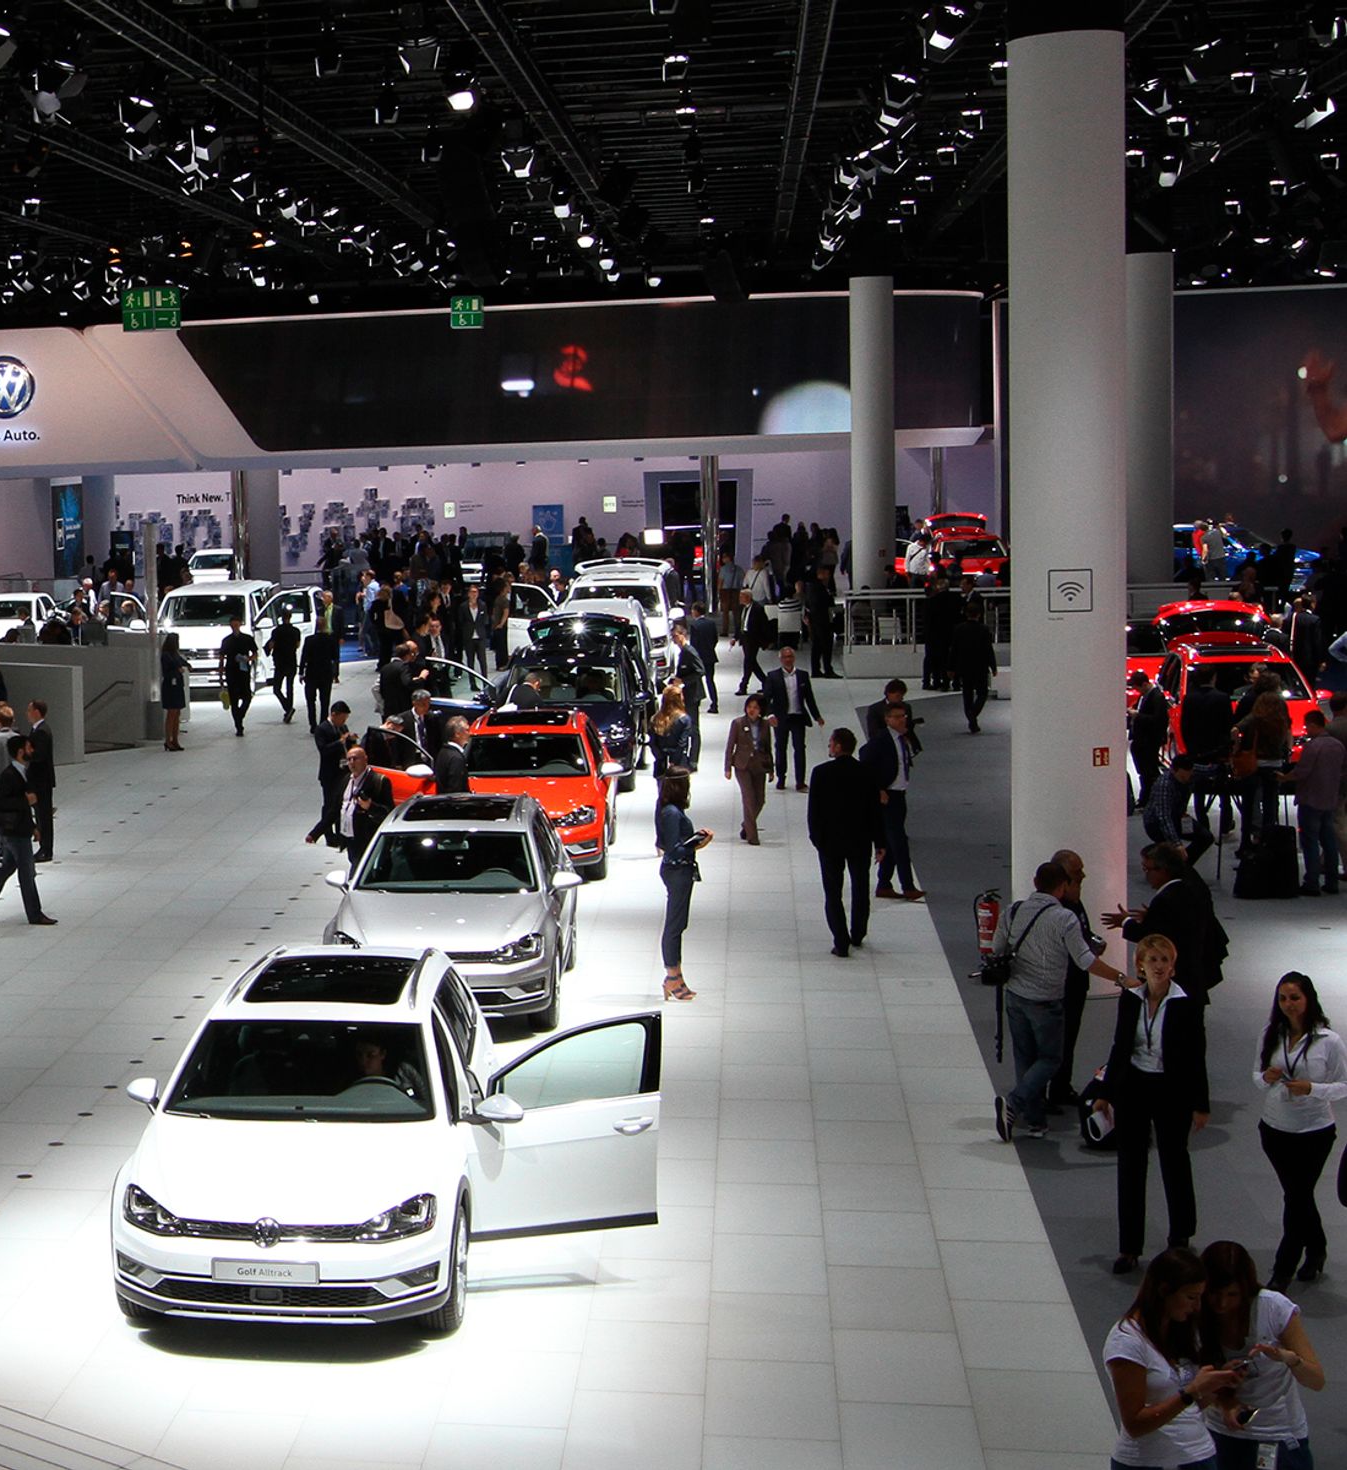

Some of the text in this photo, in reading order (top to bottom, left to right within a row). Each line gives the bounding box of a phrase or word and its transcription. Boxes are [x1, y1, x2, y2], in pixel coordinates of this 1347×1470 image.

[3, 429, 40, 441] Auto.
[176, 493, 200, 504] Think
[202, 492, 224, 503] New.
[237, 1267, 293, 1277] Golf Alltrack
